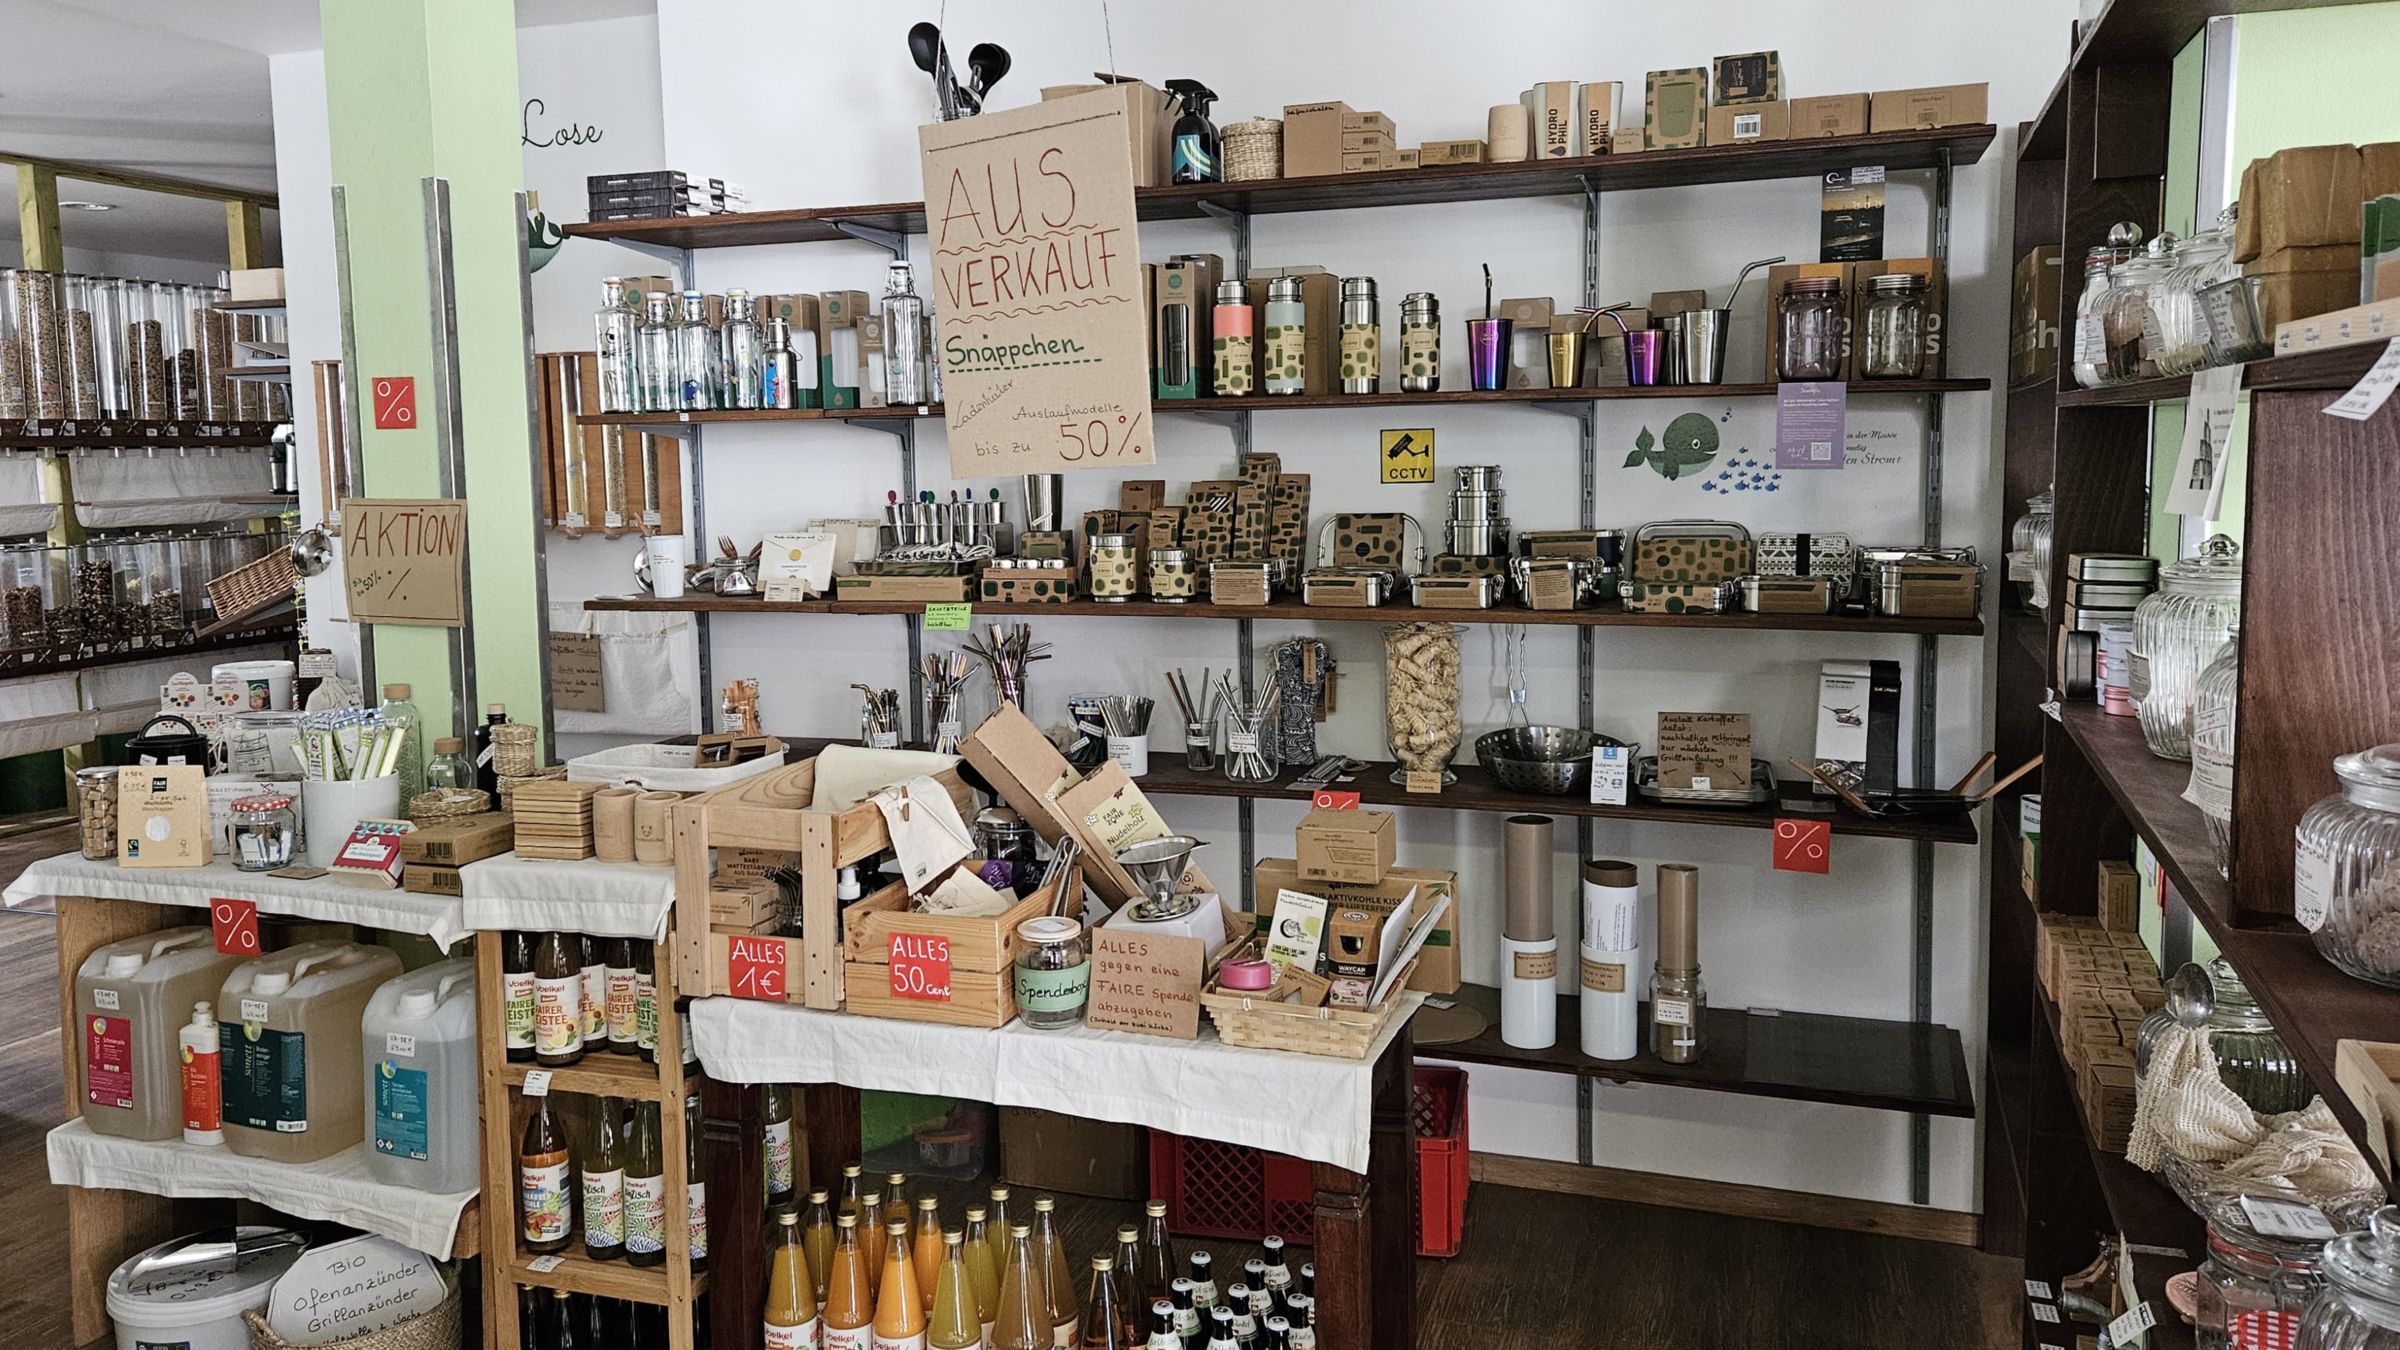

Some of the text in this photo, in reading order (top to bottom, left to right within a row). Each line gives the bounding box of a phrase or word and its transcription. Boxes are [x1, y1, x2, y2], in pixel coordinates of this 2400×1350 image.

[522, 98, 603, 148] Lose
[1548, 108, 1558, 145] HYDRO
[1558, 119, 1567, 144] PHIL
[1589, 109, 1599, 145] HYDRO
[1599, 120, 1609, 145] PHIL
[941, 147, 1076, 246] AUS
[941, 227, 1120, 309] VERKAUF
[945, 333, 1085, 366] Snäppchen
[377, 380, 412, 423] %
[1012, 402, 1124, 421] Auslaufmodelle
[975, 411, 1143, 461] bis zu 50%
[1389, 467, 1427, 479] CCTV
[1106, 815, 1145, 846] Nudelholz
[1778, 821, 1823, 860] %
[216, 904, 256, 950] %
[731, 939, 785, 965] ALLES
[892, 936, 949, 962] ALLES
[1099, 940, 1148, 956] ALLES
[608, 973, 636, 982] Voelkel
[893, 963, 951, 997] 50 Cent
[1100, 960, 1180, 977] gegen eine
[1338, 965, 1366, 973] WAYCAP
[508, 980, 534, 988] Voelk
[535, 984, 565, 993] Voelkel
[736, 967, 782, 997] 1€
[1096, 980, 1194, 1004] FAIRE Spende
[535, 1004, 563, 1014] FAIRER
[607, 993, 634, 1003] FAIRER
[1097, 1001, 1172, 1019] abzugeben
[507, 1010, 535, 1020] EIST
[535, 1014, 568, 1025] EISTEE
[307, 1287, 419, 1334] Grillanzünder
